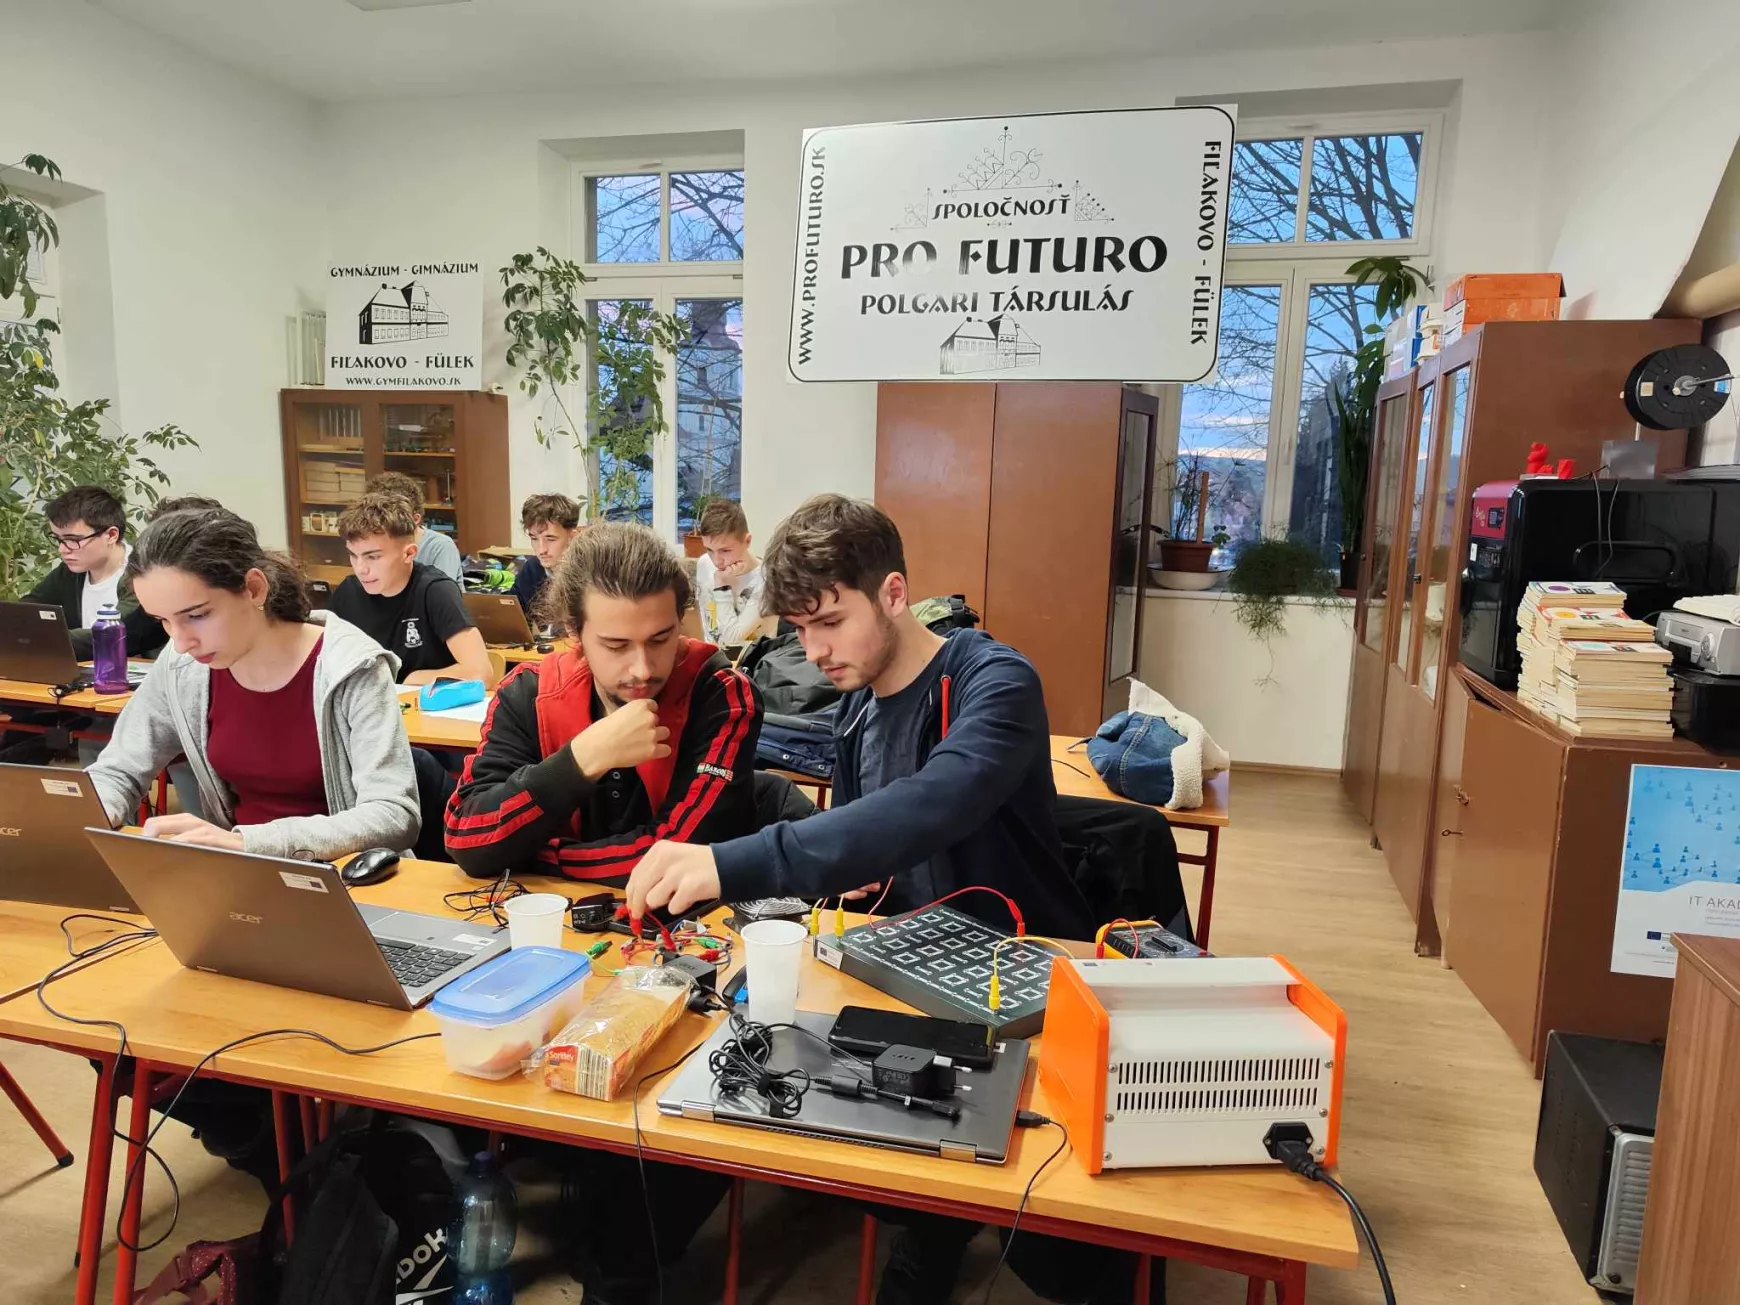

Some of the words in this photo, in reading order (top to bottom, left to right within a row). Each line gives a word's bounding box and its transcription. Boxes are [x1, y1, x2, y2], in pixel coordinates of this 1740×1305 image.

[930, 194, 1070, 221] SPOLOČNOSŤ
[797, 146, 826, 366] WWW.PROFUTURO.SK
[840, 240, 937, 279] PRO
[958, 235, 1168, 276] FUTURO
[330, 264, 400, 278] GYMNÁZIUM
[411, 261, 478, 275] GIMNÁZIUM
[989, 284, 1135, 312] TÁRSULÁS
[1190, 275, 1216, 345] FÜLEK
[426, 352, 474, 369] FÜLEK
[0, 827, 22, 837] cer
[1689, 895, 1704, 906] IT
[229, 911, 264, 924] acer
